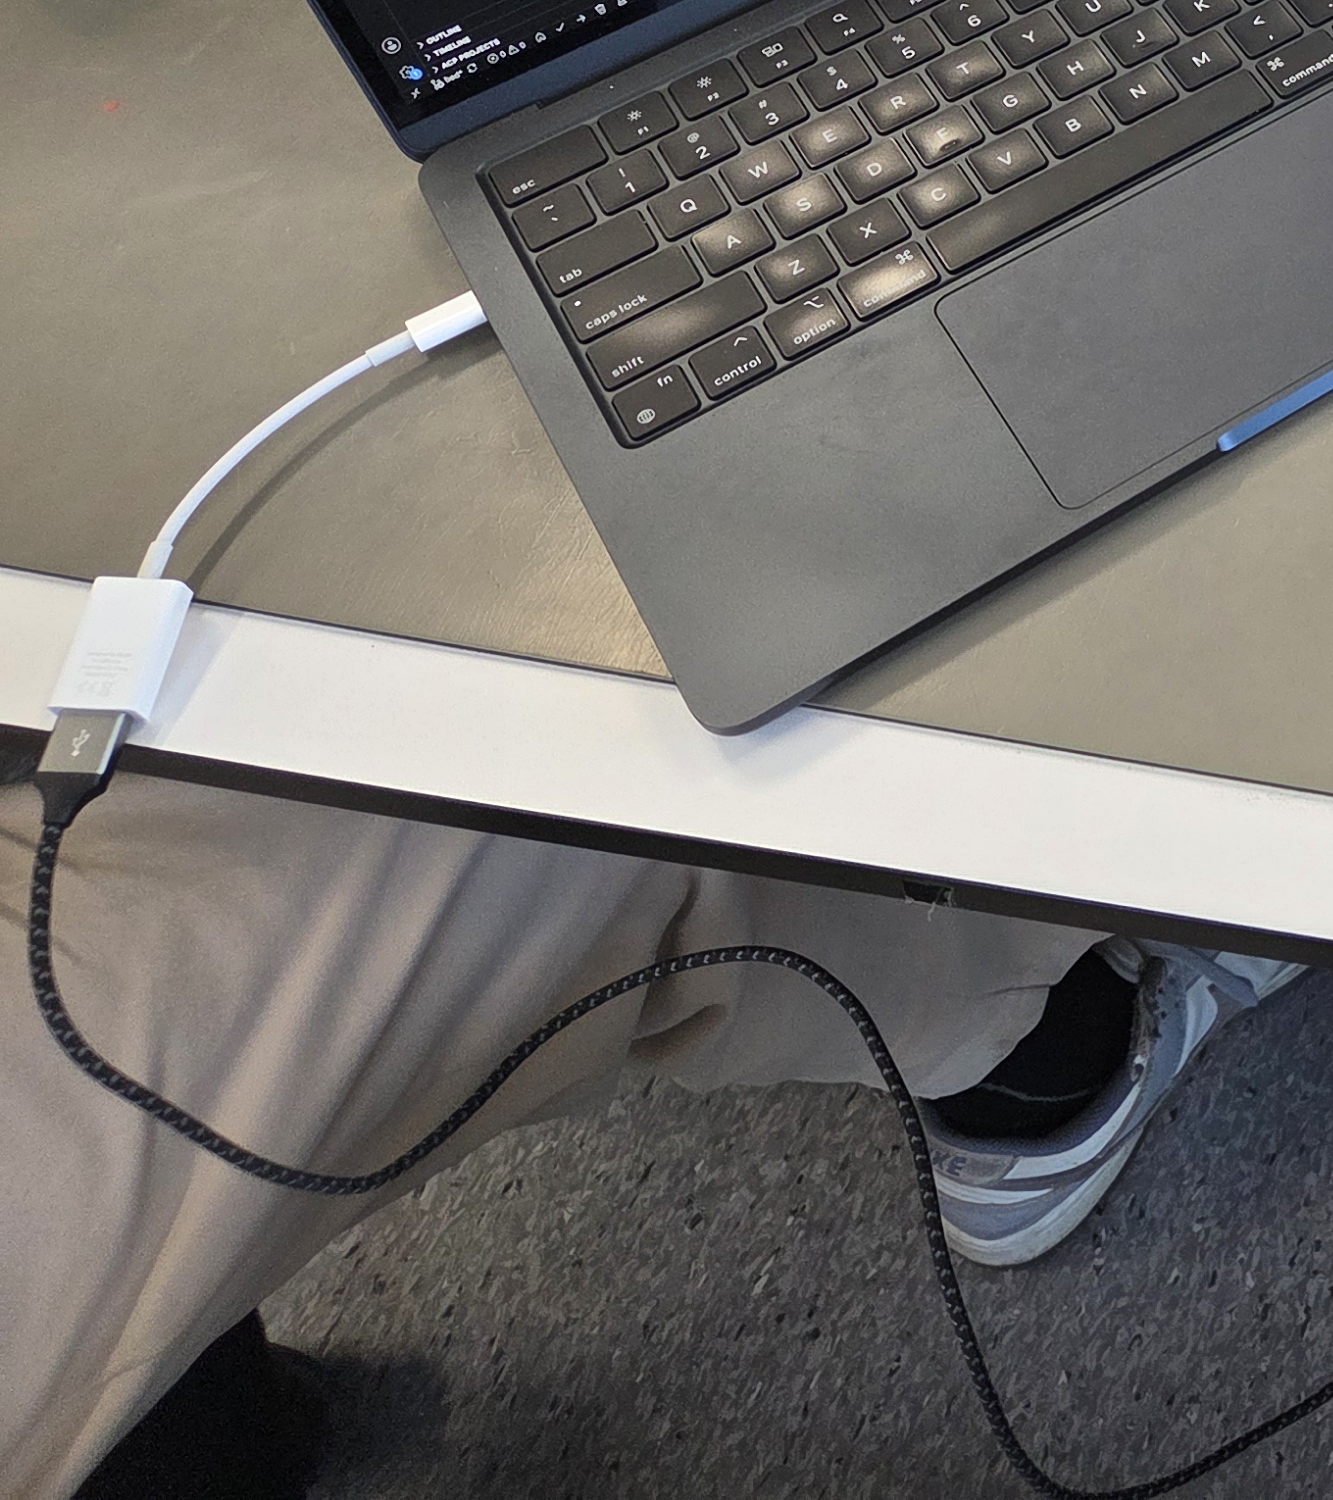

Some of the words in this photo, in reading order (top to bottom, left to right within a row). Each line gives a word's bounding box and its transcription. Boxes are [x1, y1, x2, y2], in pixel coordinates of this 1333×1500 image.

[512, 178, 536, 195] esc
[559, 266, 583, 284] tab
[584, 307, 618, 332] caps
[618, 292, 648, 316] lock
[793, 316, 836, 347] option
[611, 356, 645, 379] shift
[713, 356, 763, 387] control
